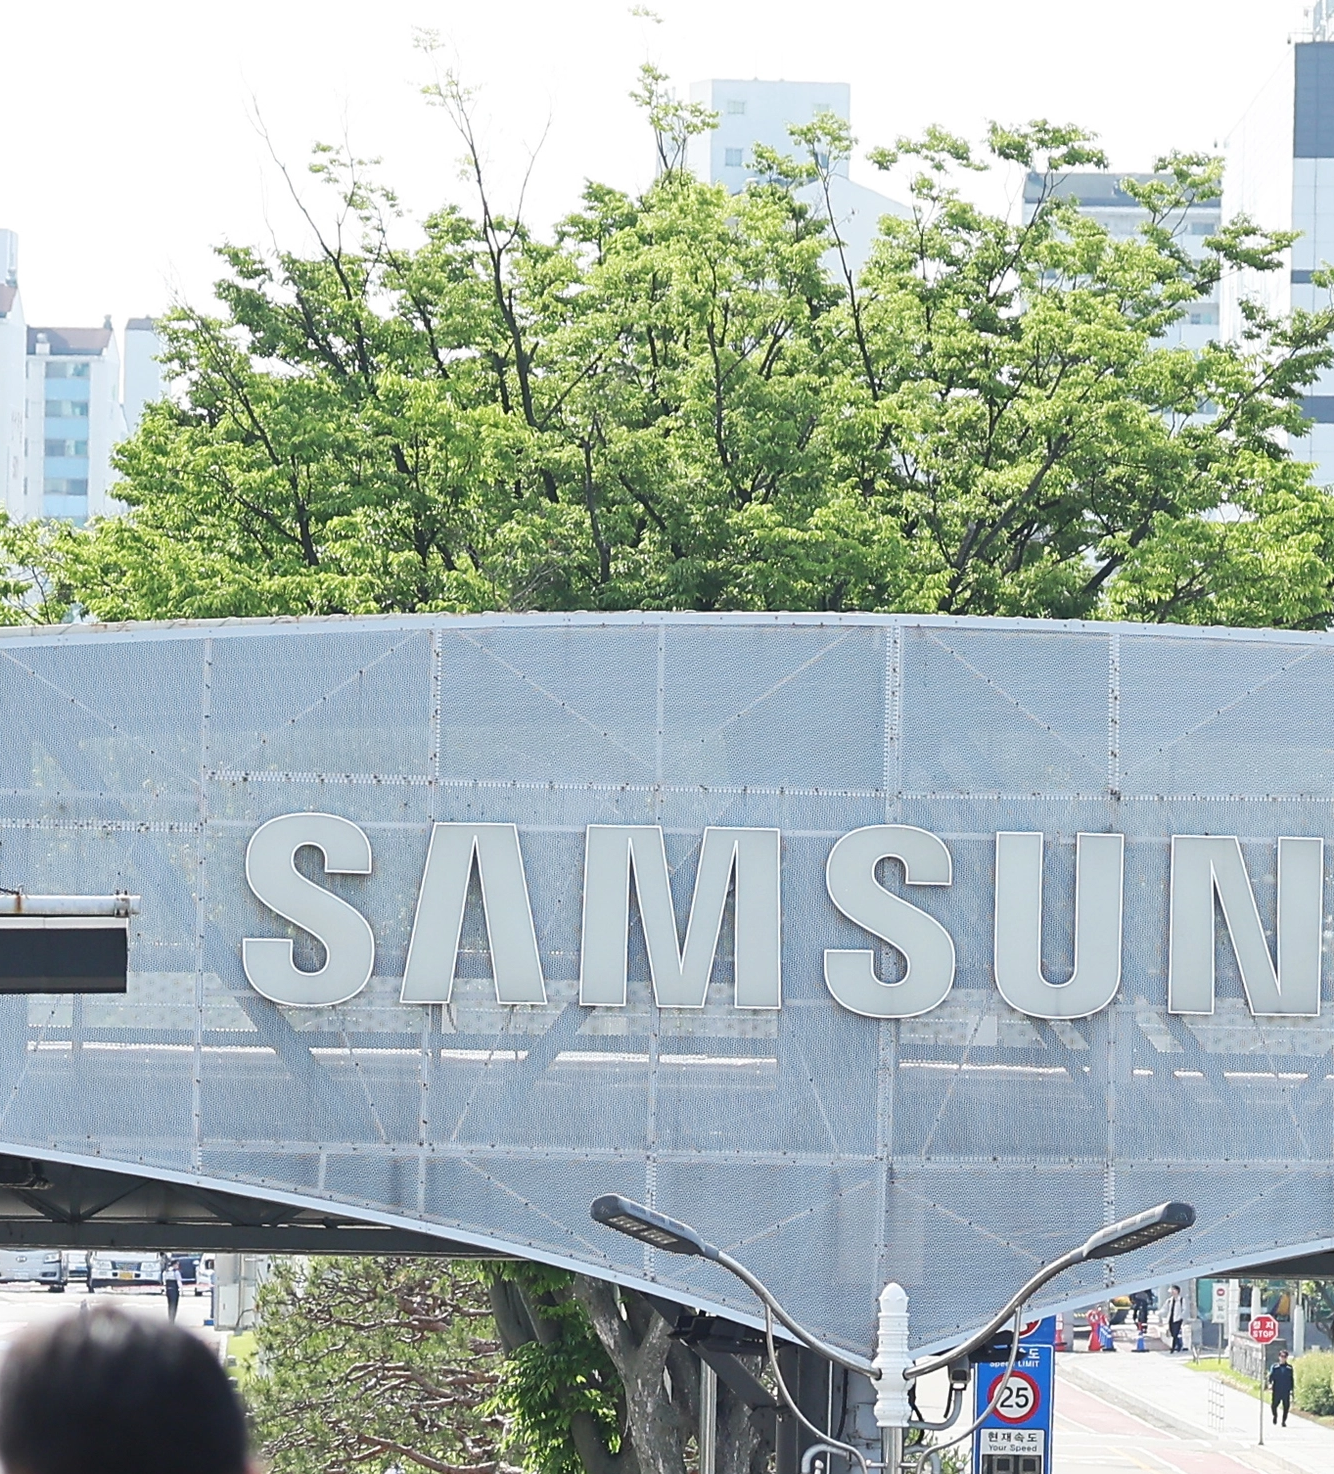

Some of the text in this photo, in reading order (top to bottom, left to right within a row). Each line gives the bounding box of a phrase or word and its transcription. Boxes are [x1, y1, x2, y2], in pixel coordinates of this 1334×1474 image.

[1253, 1330, 1274, 1338] STOP
[1017, 1360, 1040, 1368] LIMIT
[999, 1386, 1029, 1408] 25
[988, 1432, 1037, 1442] 현재속도
[1010, 1444, 1037, 1452] Speed
